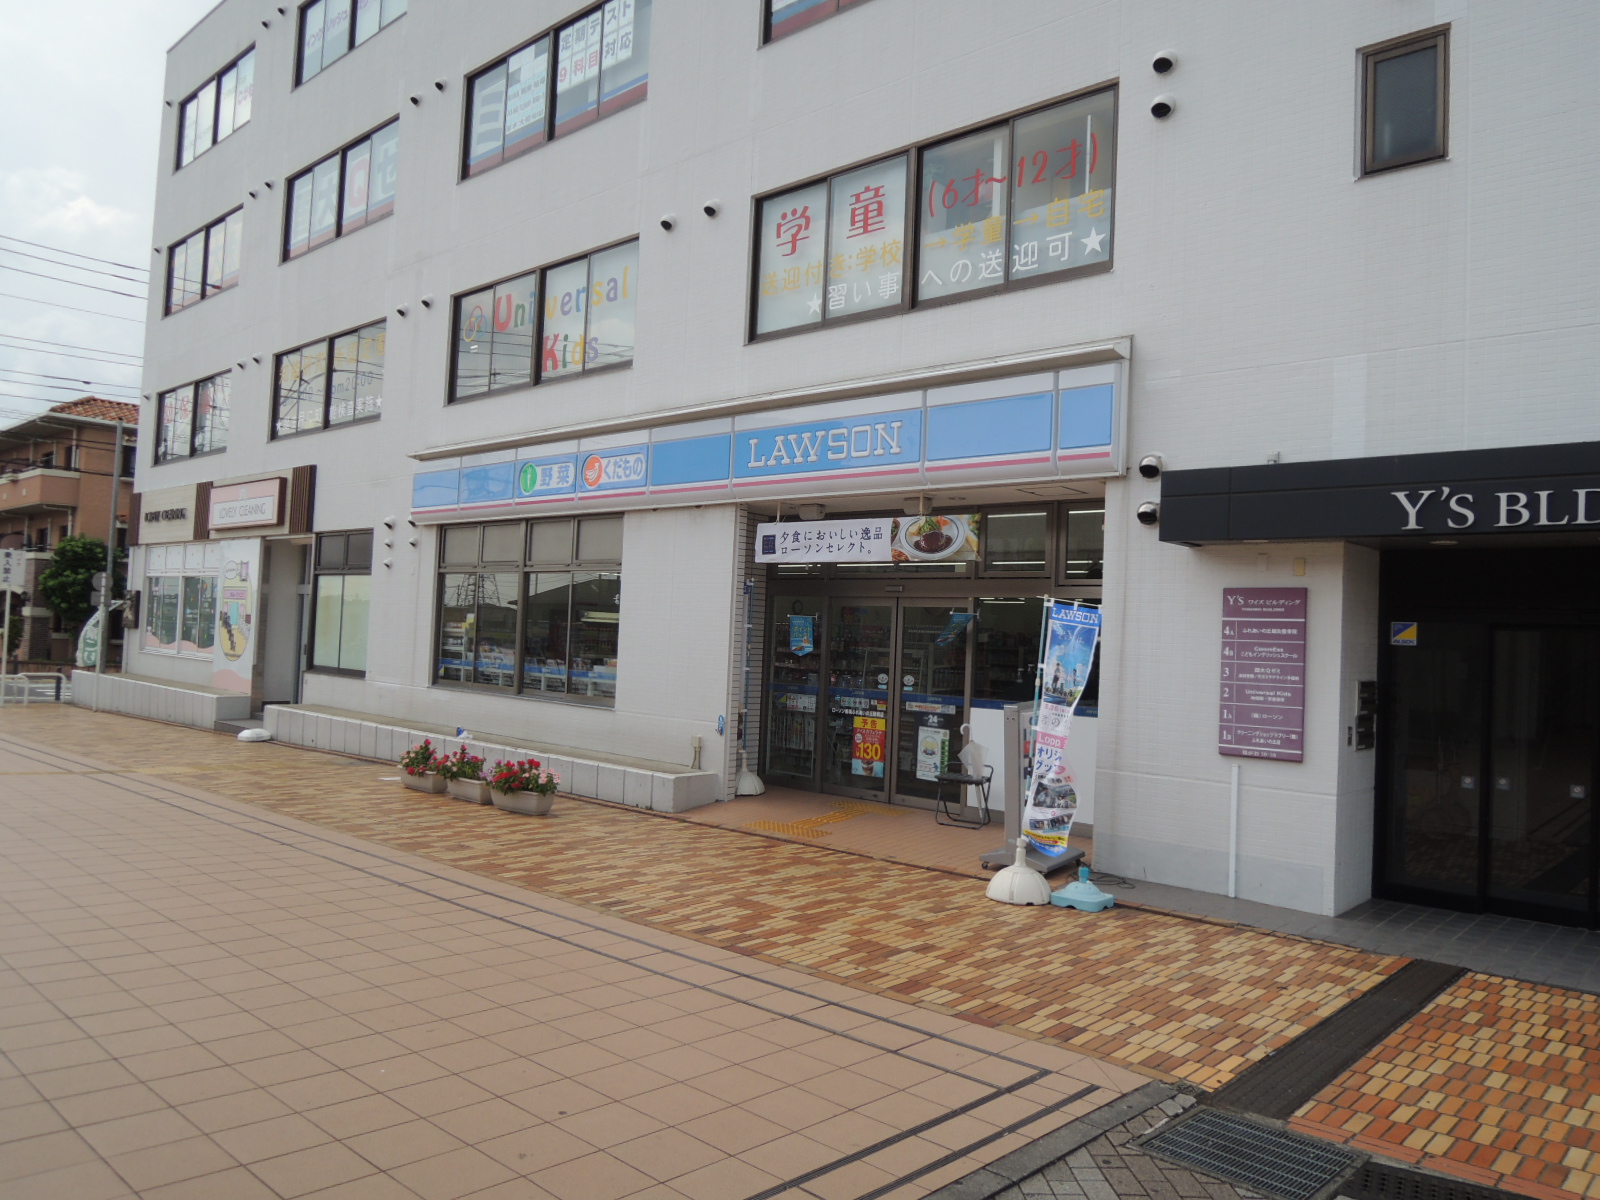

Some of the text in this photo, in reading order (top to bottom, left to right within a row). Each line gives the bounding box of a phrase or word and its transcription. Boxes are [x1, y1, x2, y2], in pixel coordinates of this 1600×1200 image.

[560, 1, 632, 52] 定期テスト
[559, 31, 632, 83] 9科目対応
[776, 185, 886, 257] 学童
[494, 265, 630, 332] Universal
[542, 333, 599, 373] Kids
[748, 421, 902, 469] LAWSON
[540, 465, 572, 488] 野菜
[603, 458, 644, 482] くだもの
[218, 503, 266, 519] LOVELY CLEANING
[1391, 486, 1475, 530] Y'S
[780, 526, 884, 545] 夕食においしい逸品
[1226, 595, 1245, 606] Y'S
[1051, 607, 1099, 624] LAWSON
[1222, 667, 1230, 677] 3
[1223, 687, 1229, 697] 2
[1245, 689, 1276, 697] Universal
[861, 718, 878, 729] 予告
[928, 714, 938, 723] 24
